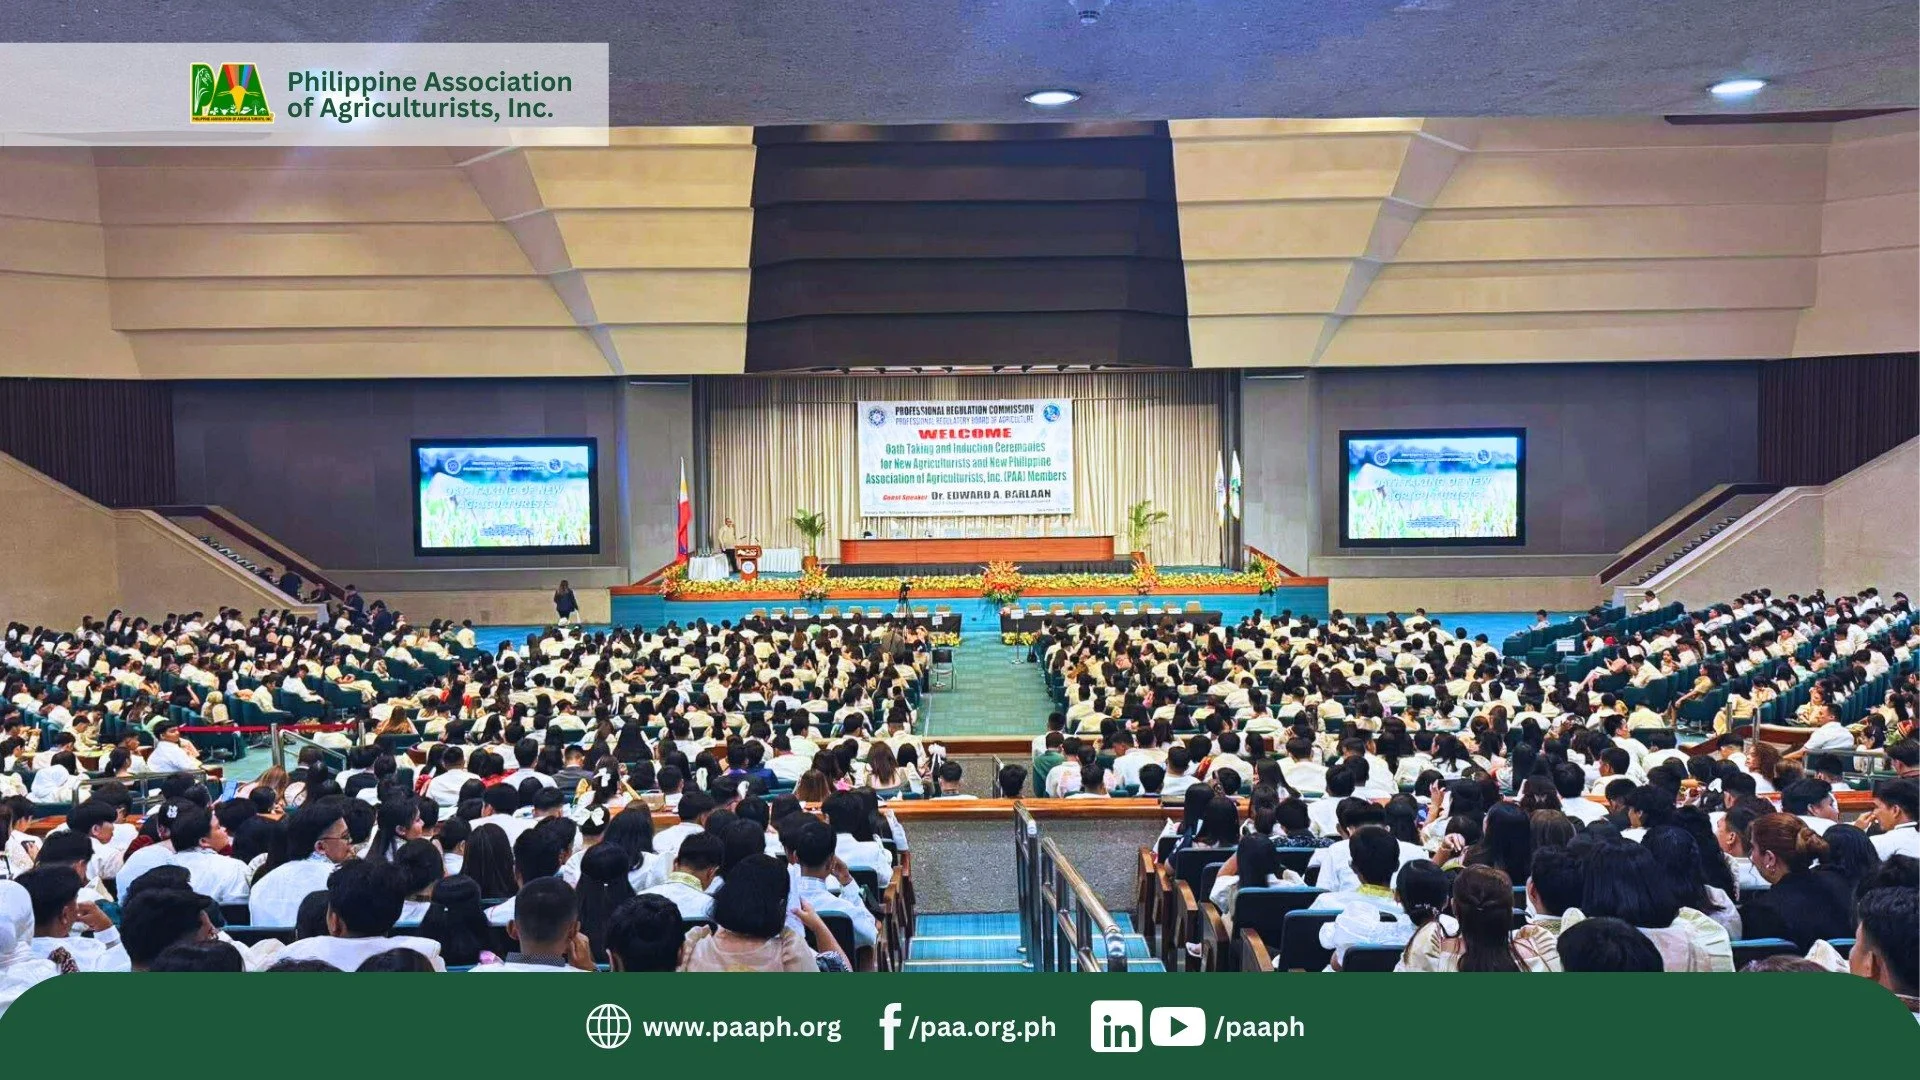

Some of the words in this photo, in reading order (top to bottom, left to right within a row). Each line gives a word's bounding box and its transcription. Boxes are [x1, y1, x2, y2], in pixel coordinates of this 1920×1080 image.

[895, 406, 945, 416] PROFESSIONAL
[946, 405, 987, 415] REGULATION
[988, 404, 1034, 414] COMMISSION
[895, 417, 935, 425] PROFESSIONAL
[936, 416, 970, 425] REGULATORY
[971, 416, 989, 424] BOARD
[918, 428, 1012, 439] WELCOME
[886, 443, 905, 454] Oath
[906, 443, 933, 455] Taking
[935, 442, 951, 453] and
[953, 442, 993, 453] Induction
[995, 441, 1046, 453] Ceremonies
[880, 458, 892, 469] for
[894, 458, 912, 469] New
[913, 457, 971, 470] Agriculturists
[972, 457, 988, 468] and
[989, 457, 1007, 468] New
[1008, 456, 1051, 468] Philippine
[865, 473, 915, 484] Association
[916, 473, 925, 484] of
[926, 472, 986, 484] Agriculturists,
[987, 471, 1003, 483] Inc.
[1027, 470, 1067, 482] Members
[931, 491, 945, 500] Dr.
[947, 490, 991, 500] EDWARD
[1004, 489, 1051, 499] BARLAAN
